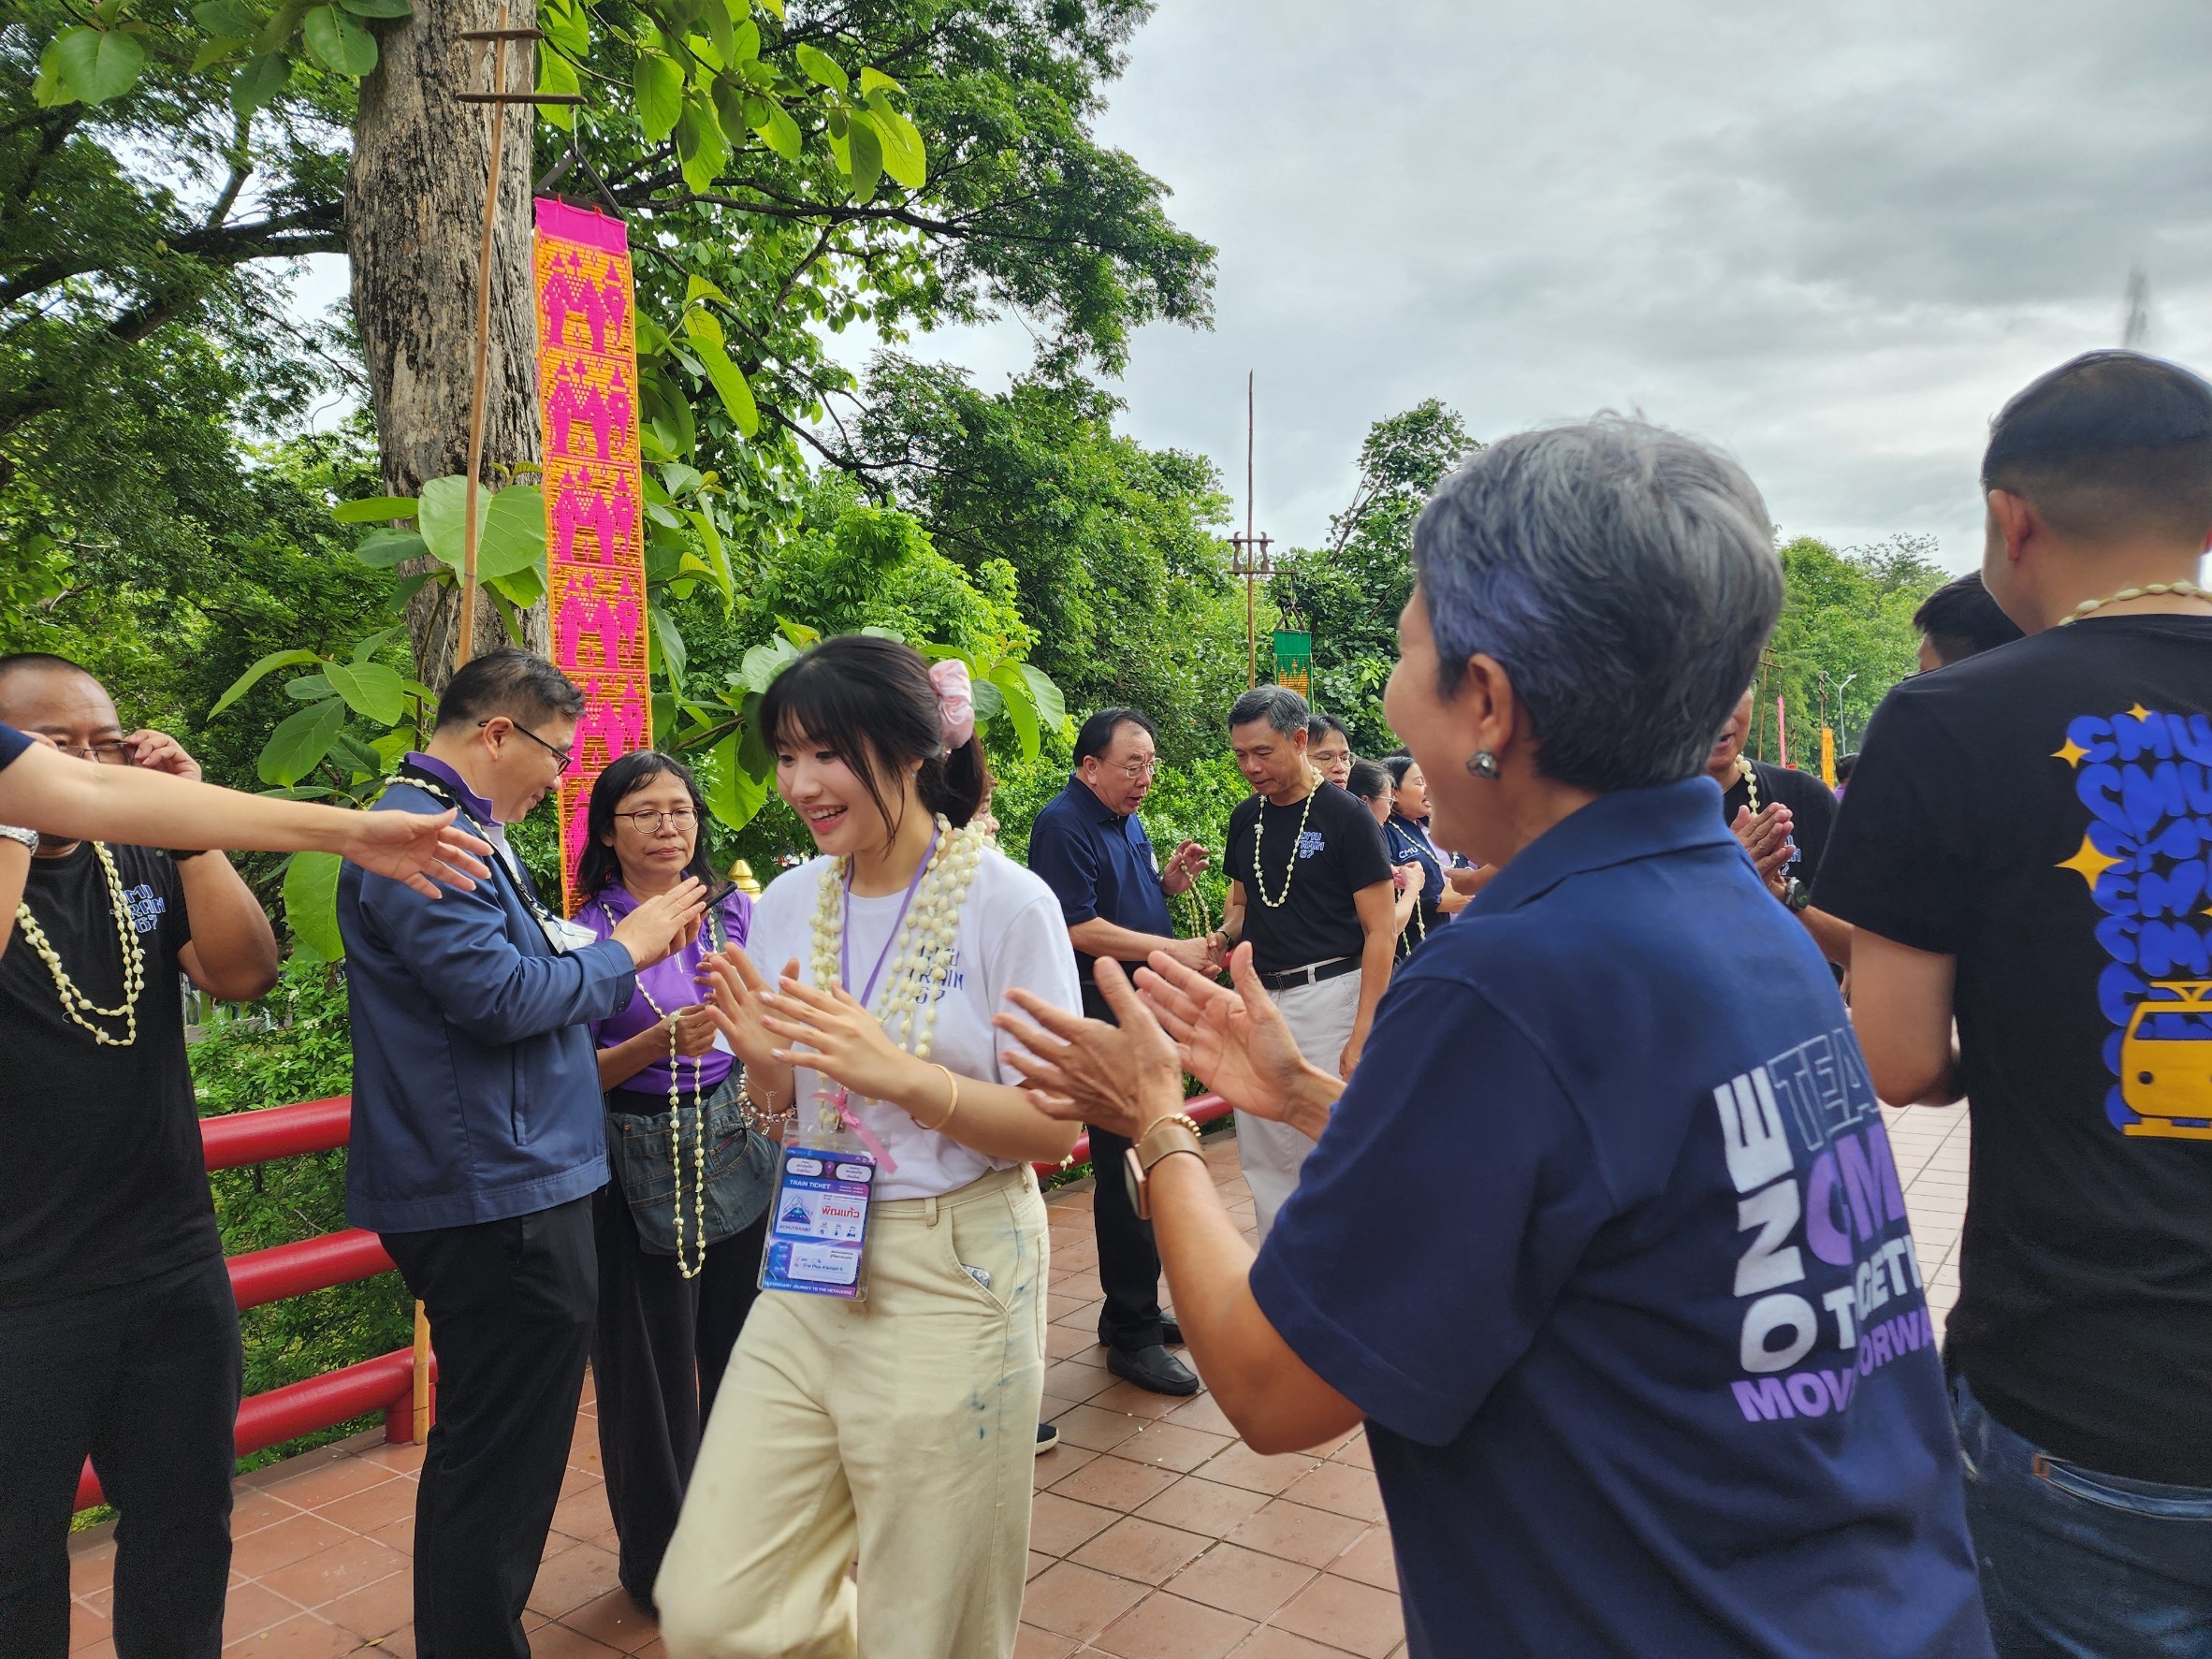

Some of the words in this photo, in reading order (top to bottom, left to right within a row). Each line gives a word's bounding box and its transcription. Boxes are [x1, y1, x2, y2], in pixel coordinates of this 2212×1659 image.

[1398, 847, 1419, 859] CMU
[134, 914, 158, 933] 67
[1767, 1026, 1879, 1152] TEA
[789, 1179, 808, 1187] TRAIN
[808, 1181, 831, 1189] TICKET
[1729, 1367, 1854, 1422] MOV
